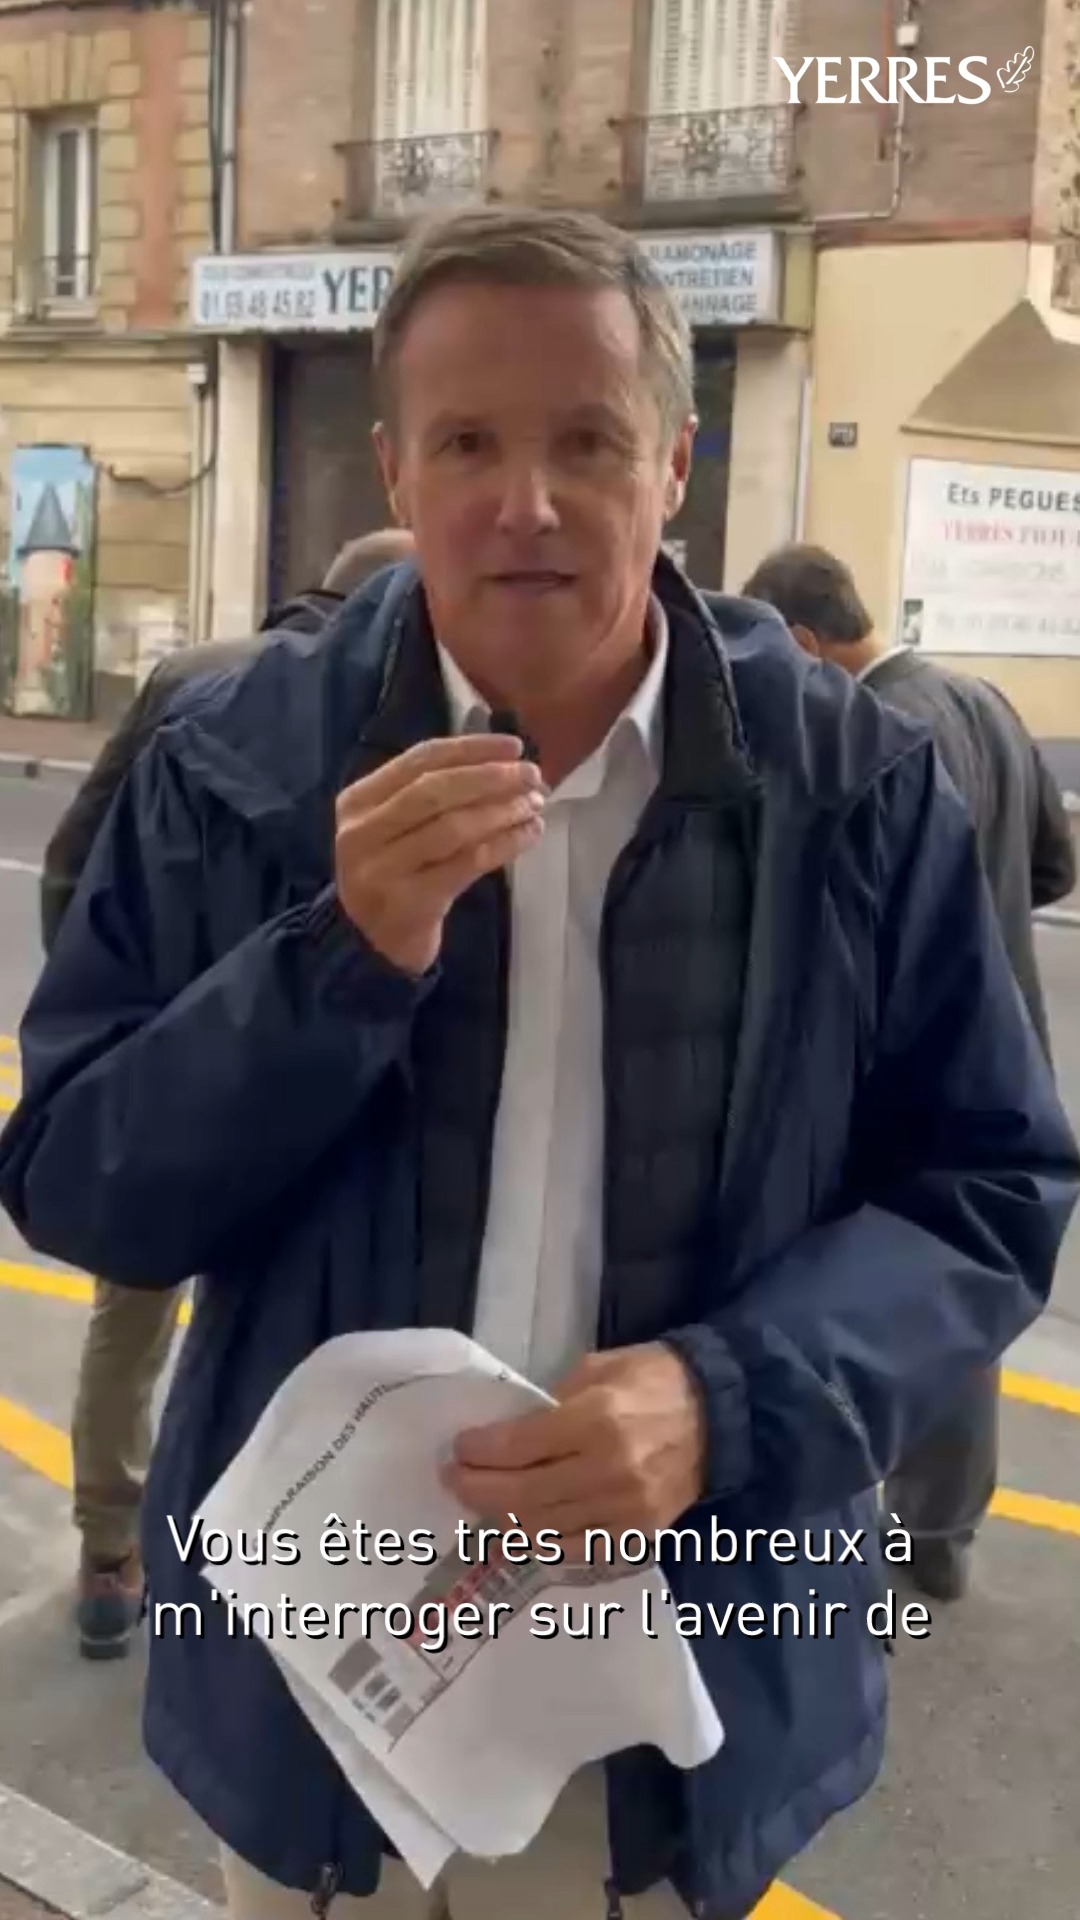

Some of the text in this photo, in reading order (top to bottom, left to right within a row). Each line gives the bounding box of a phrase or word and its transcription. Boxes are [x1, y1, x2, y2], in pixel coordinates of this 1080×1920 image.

[664, 267, 754, 287] NTRETIEN
[321, 265, 394, 314] YER
[948, 482, 980, 505] Ets
